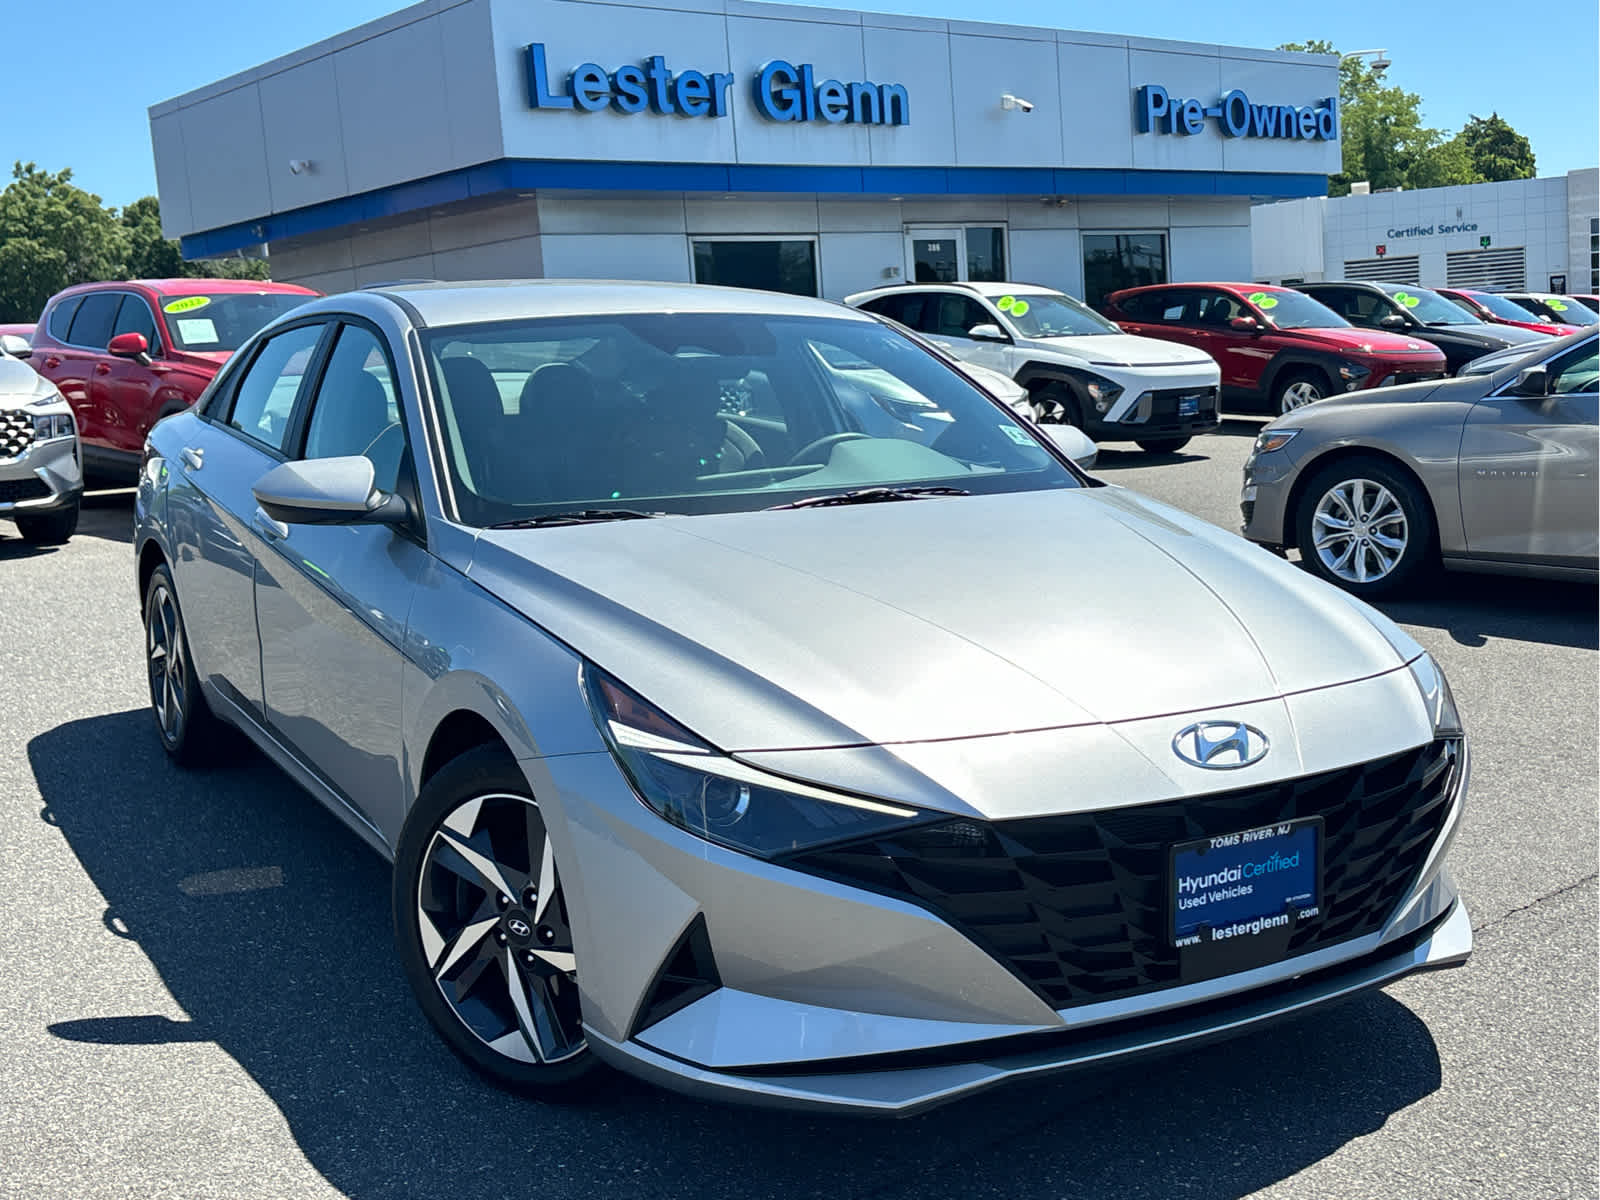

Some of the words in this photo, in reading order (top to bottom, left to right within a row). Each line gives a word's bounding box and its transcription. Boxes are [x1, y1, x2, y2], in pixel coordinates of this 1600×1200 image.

[522, 43, 734, 119] Lester
[754, 59, 910, 126] Glenn
[1136, 84, 1337, 141] Pre-Owned
[1387, 225, 1434, 239] Certified
[1438, 222, 1478, 235] Service
[1210, 834, 1240, 848] TOMS
[1277, 823, 1291, 836] NJ
[1178, 865, 1242, 894] Hyundai
[1242, 851, 1300, 879] Certified
[1179, 893, 1207, 910] Used
[1208, 884, 1254, 903] Vehicles
[1175, 935, 1202, 948] www.
[1212, 914, 1289, 941] lesterglenn
[1297, 907, 1319, 920] .com
